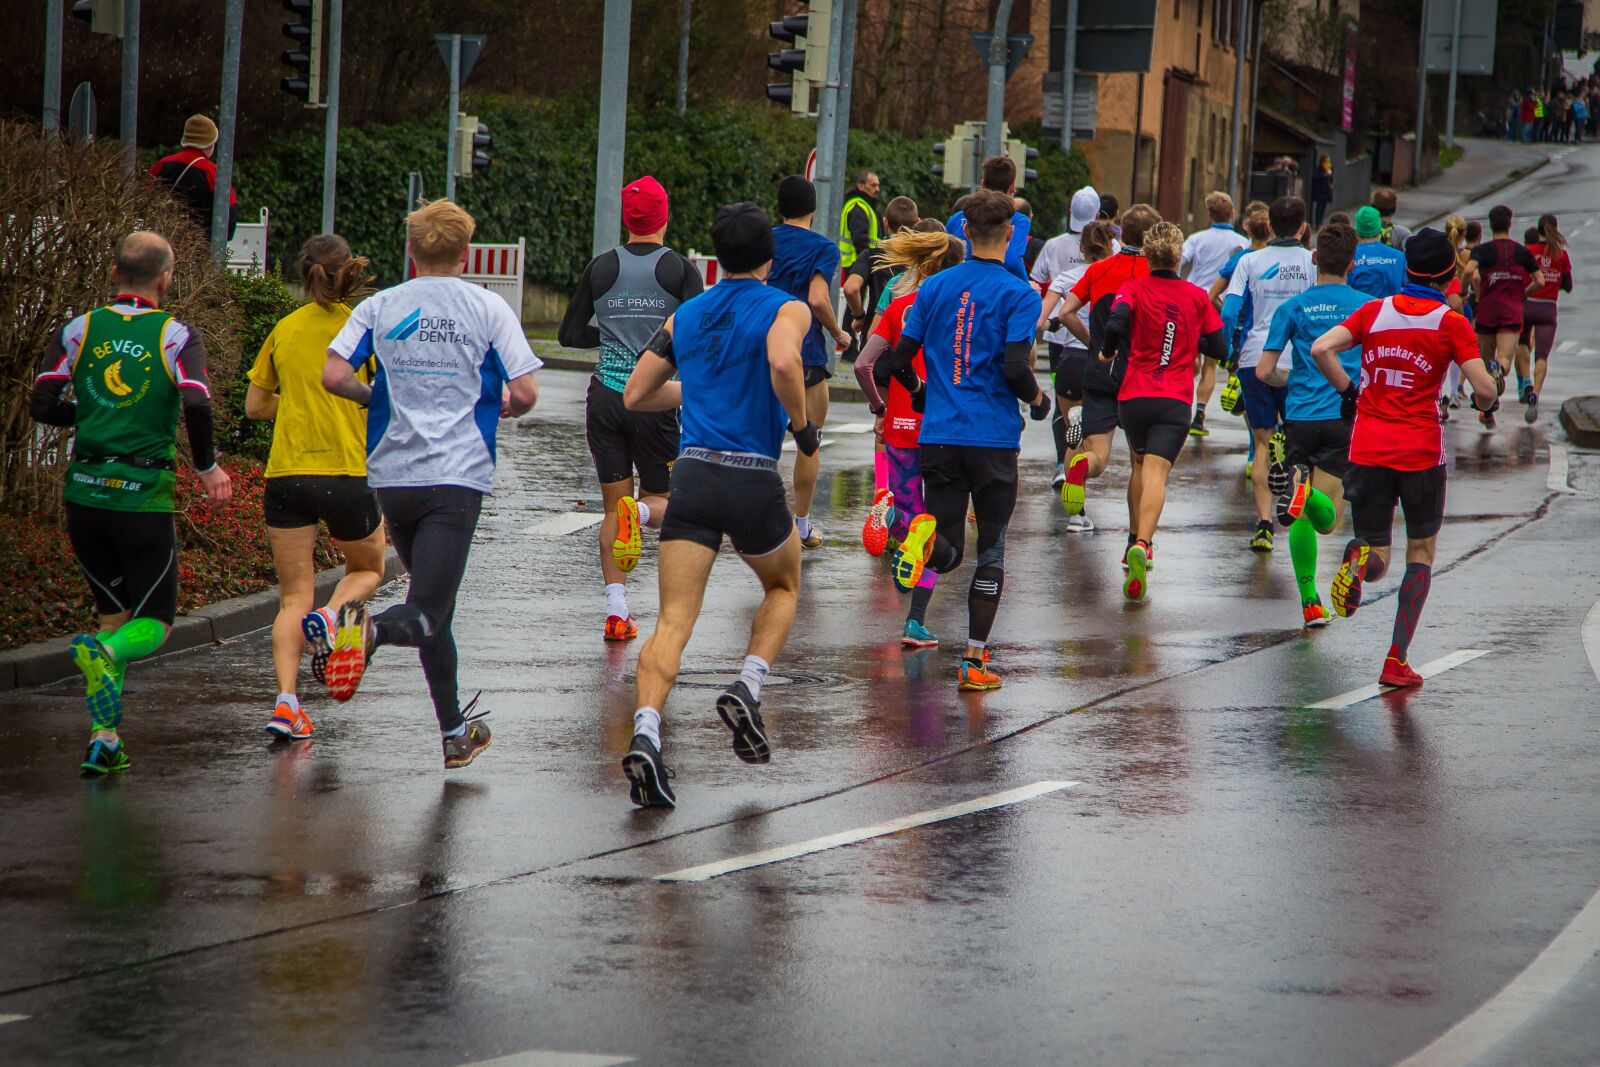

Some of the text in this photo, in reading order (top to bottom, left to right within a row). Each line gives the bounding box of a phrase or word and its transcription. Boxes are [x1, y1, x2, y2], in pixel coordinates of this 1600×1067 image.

[1280, 272, 1307, 281] DENTAL
[608, 299, 665, 309] DIE PRAXIS
[420, 316, 456, 330] DÜRR
[420, 331, 469, 346] DENTAL
[1160, 321, 1176, 366] ORTEMA
[93, 340, 152, 362] BEVEGT
[392, 357, 460, 369] Medizintechnik
[1365, 345, 1433, 374] LG Neckar-Enz
[721, 454, 755, 468] PRO
